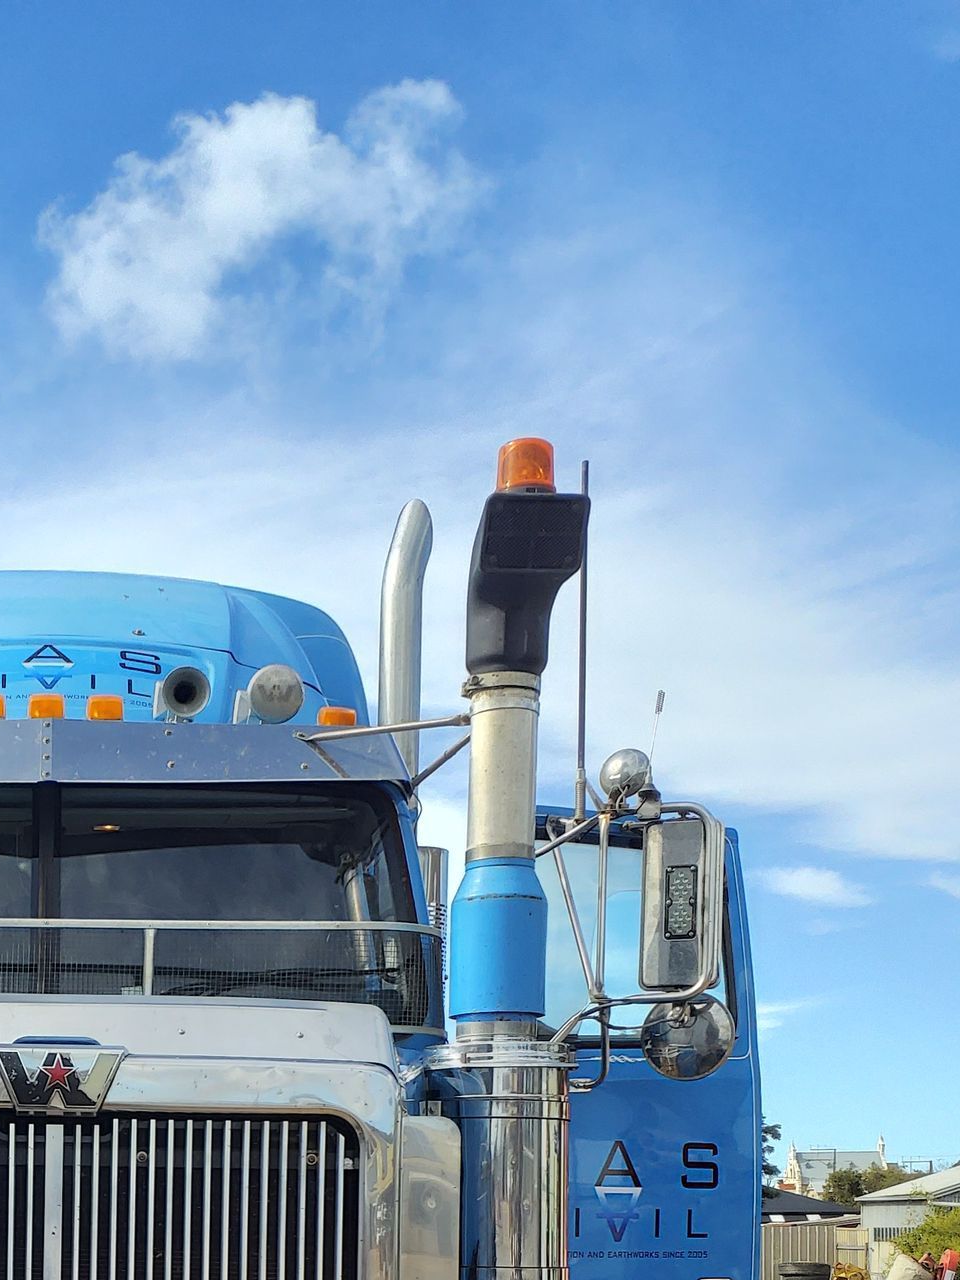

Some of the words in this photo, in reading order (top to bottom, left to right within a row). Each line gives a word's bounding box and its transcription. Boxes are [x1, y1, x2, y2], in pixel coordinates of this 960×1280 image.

[594, 1140, 719, 1189] AS
[574, 1207, 709, 1242] IVIL
[588, 1250, 605, 1259] AND
[607, 1250, 660, 1259] EARTHWORKS
[662, 1250, 685, 1259] SINCE
[687, 1250, 709, 1259] 2005
